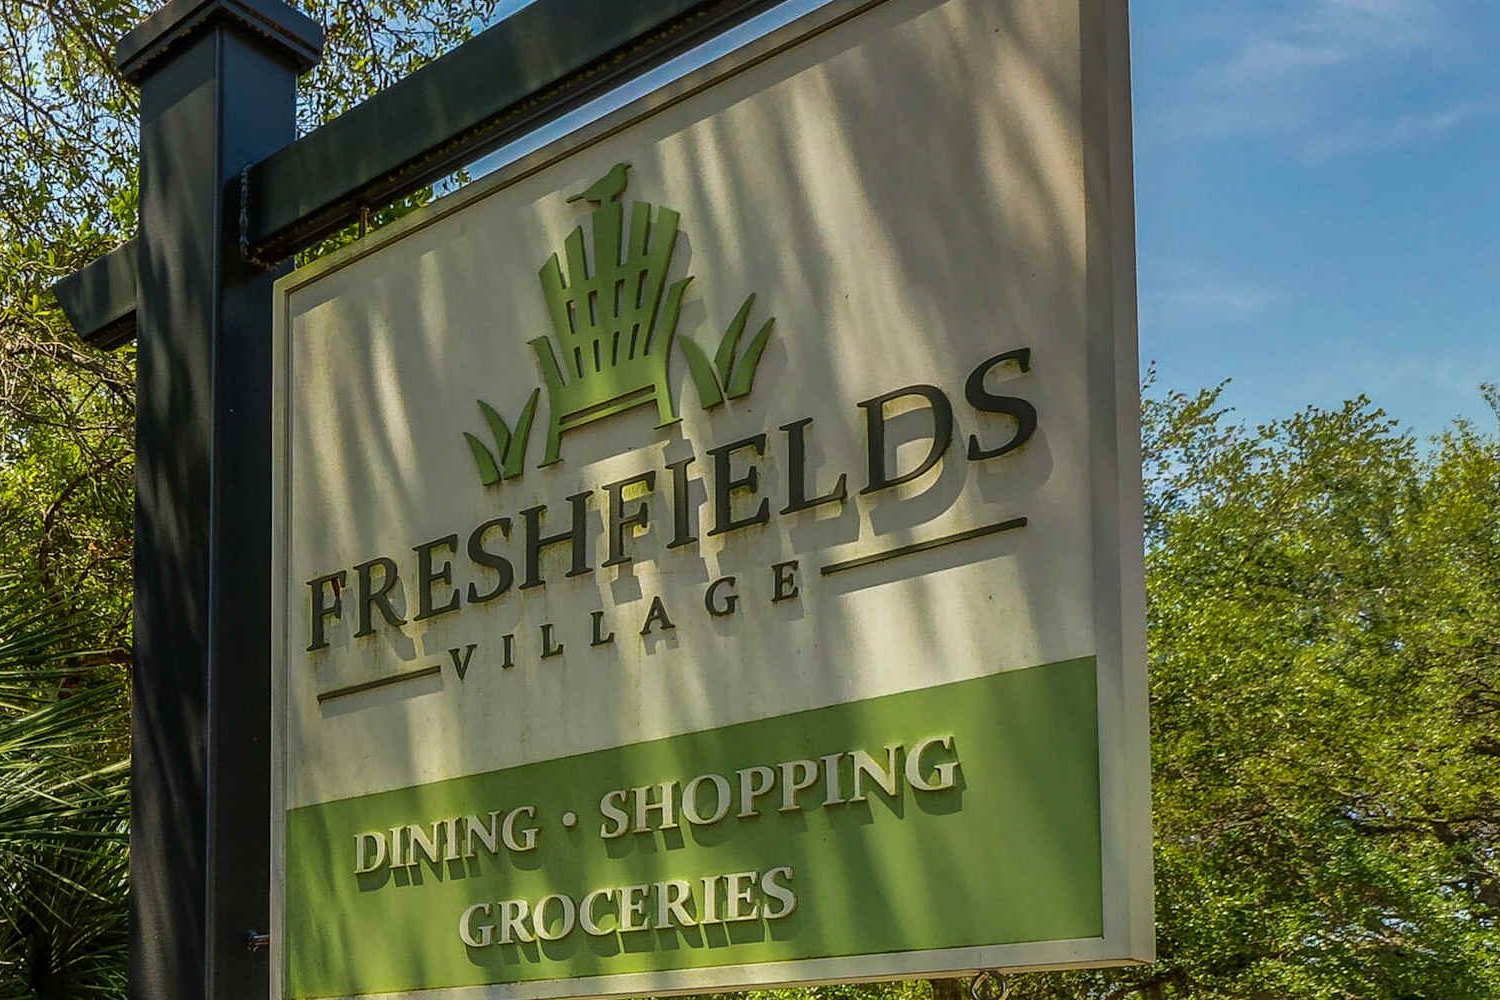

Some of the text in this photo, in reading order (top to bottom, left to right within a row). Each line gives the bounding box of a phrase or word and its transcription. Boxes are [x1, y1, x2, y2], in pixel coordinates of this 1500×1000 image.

[306, 347, 1038, 653] FRESHFIELDS
[448, 560, 801, 681] VILLAGE
[353, 735, 960, 876] DINING SHOPPING
[458, 866, 798, 950] GROCERIES
